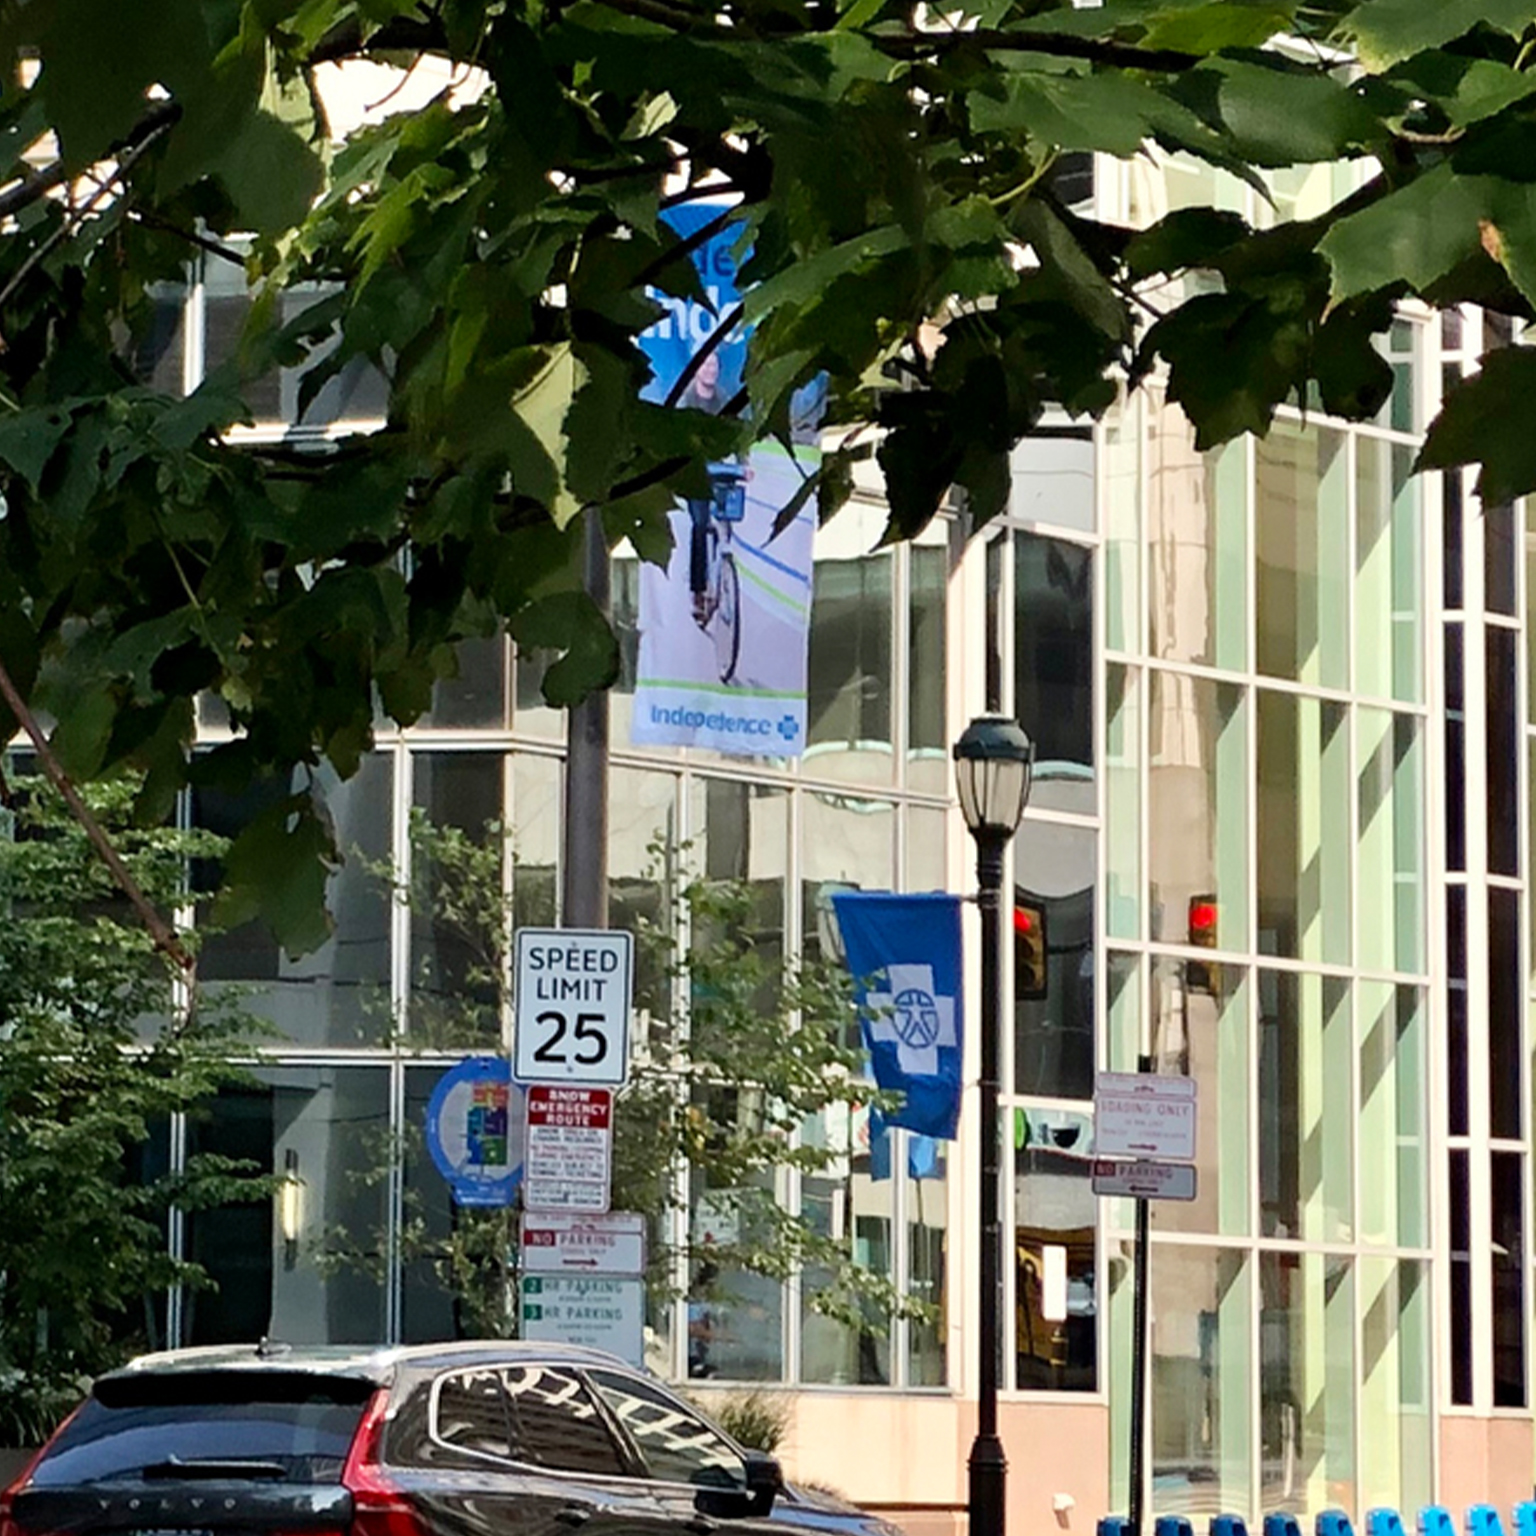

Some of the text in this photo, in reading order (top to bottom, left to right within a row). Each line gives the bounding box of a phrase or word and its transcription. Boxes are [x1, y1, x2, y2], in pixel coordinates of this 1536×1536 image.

[651, 705, 772, 736] Indepedence
[529, 947, 619, 973] SPEED
[537, 978, 608, 1001] LIMIT
[534, 1011, 608, 1066] 25
[548, 1089, 591, 1102] SNOW
[530, 1101, 608, 1114] EMERGENCY
[1157, 1104, 1188, 1117] ONLY
[546, 1114, 591, 1126] ROUTE
[531, 1233, 616, 1247] NO PARKING
[567, 1281, 623, 1294] PARKING
[567, 1308, 623, 1321] PARKING
[99, 1497, 236, 1511] VOLVO
